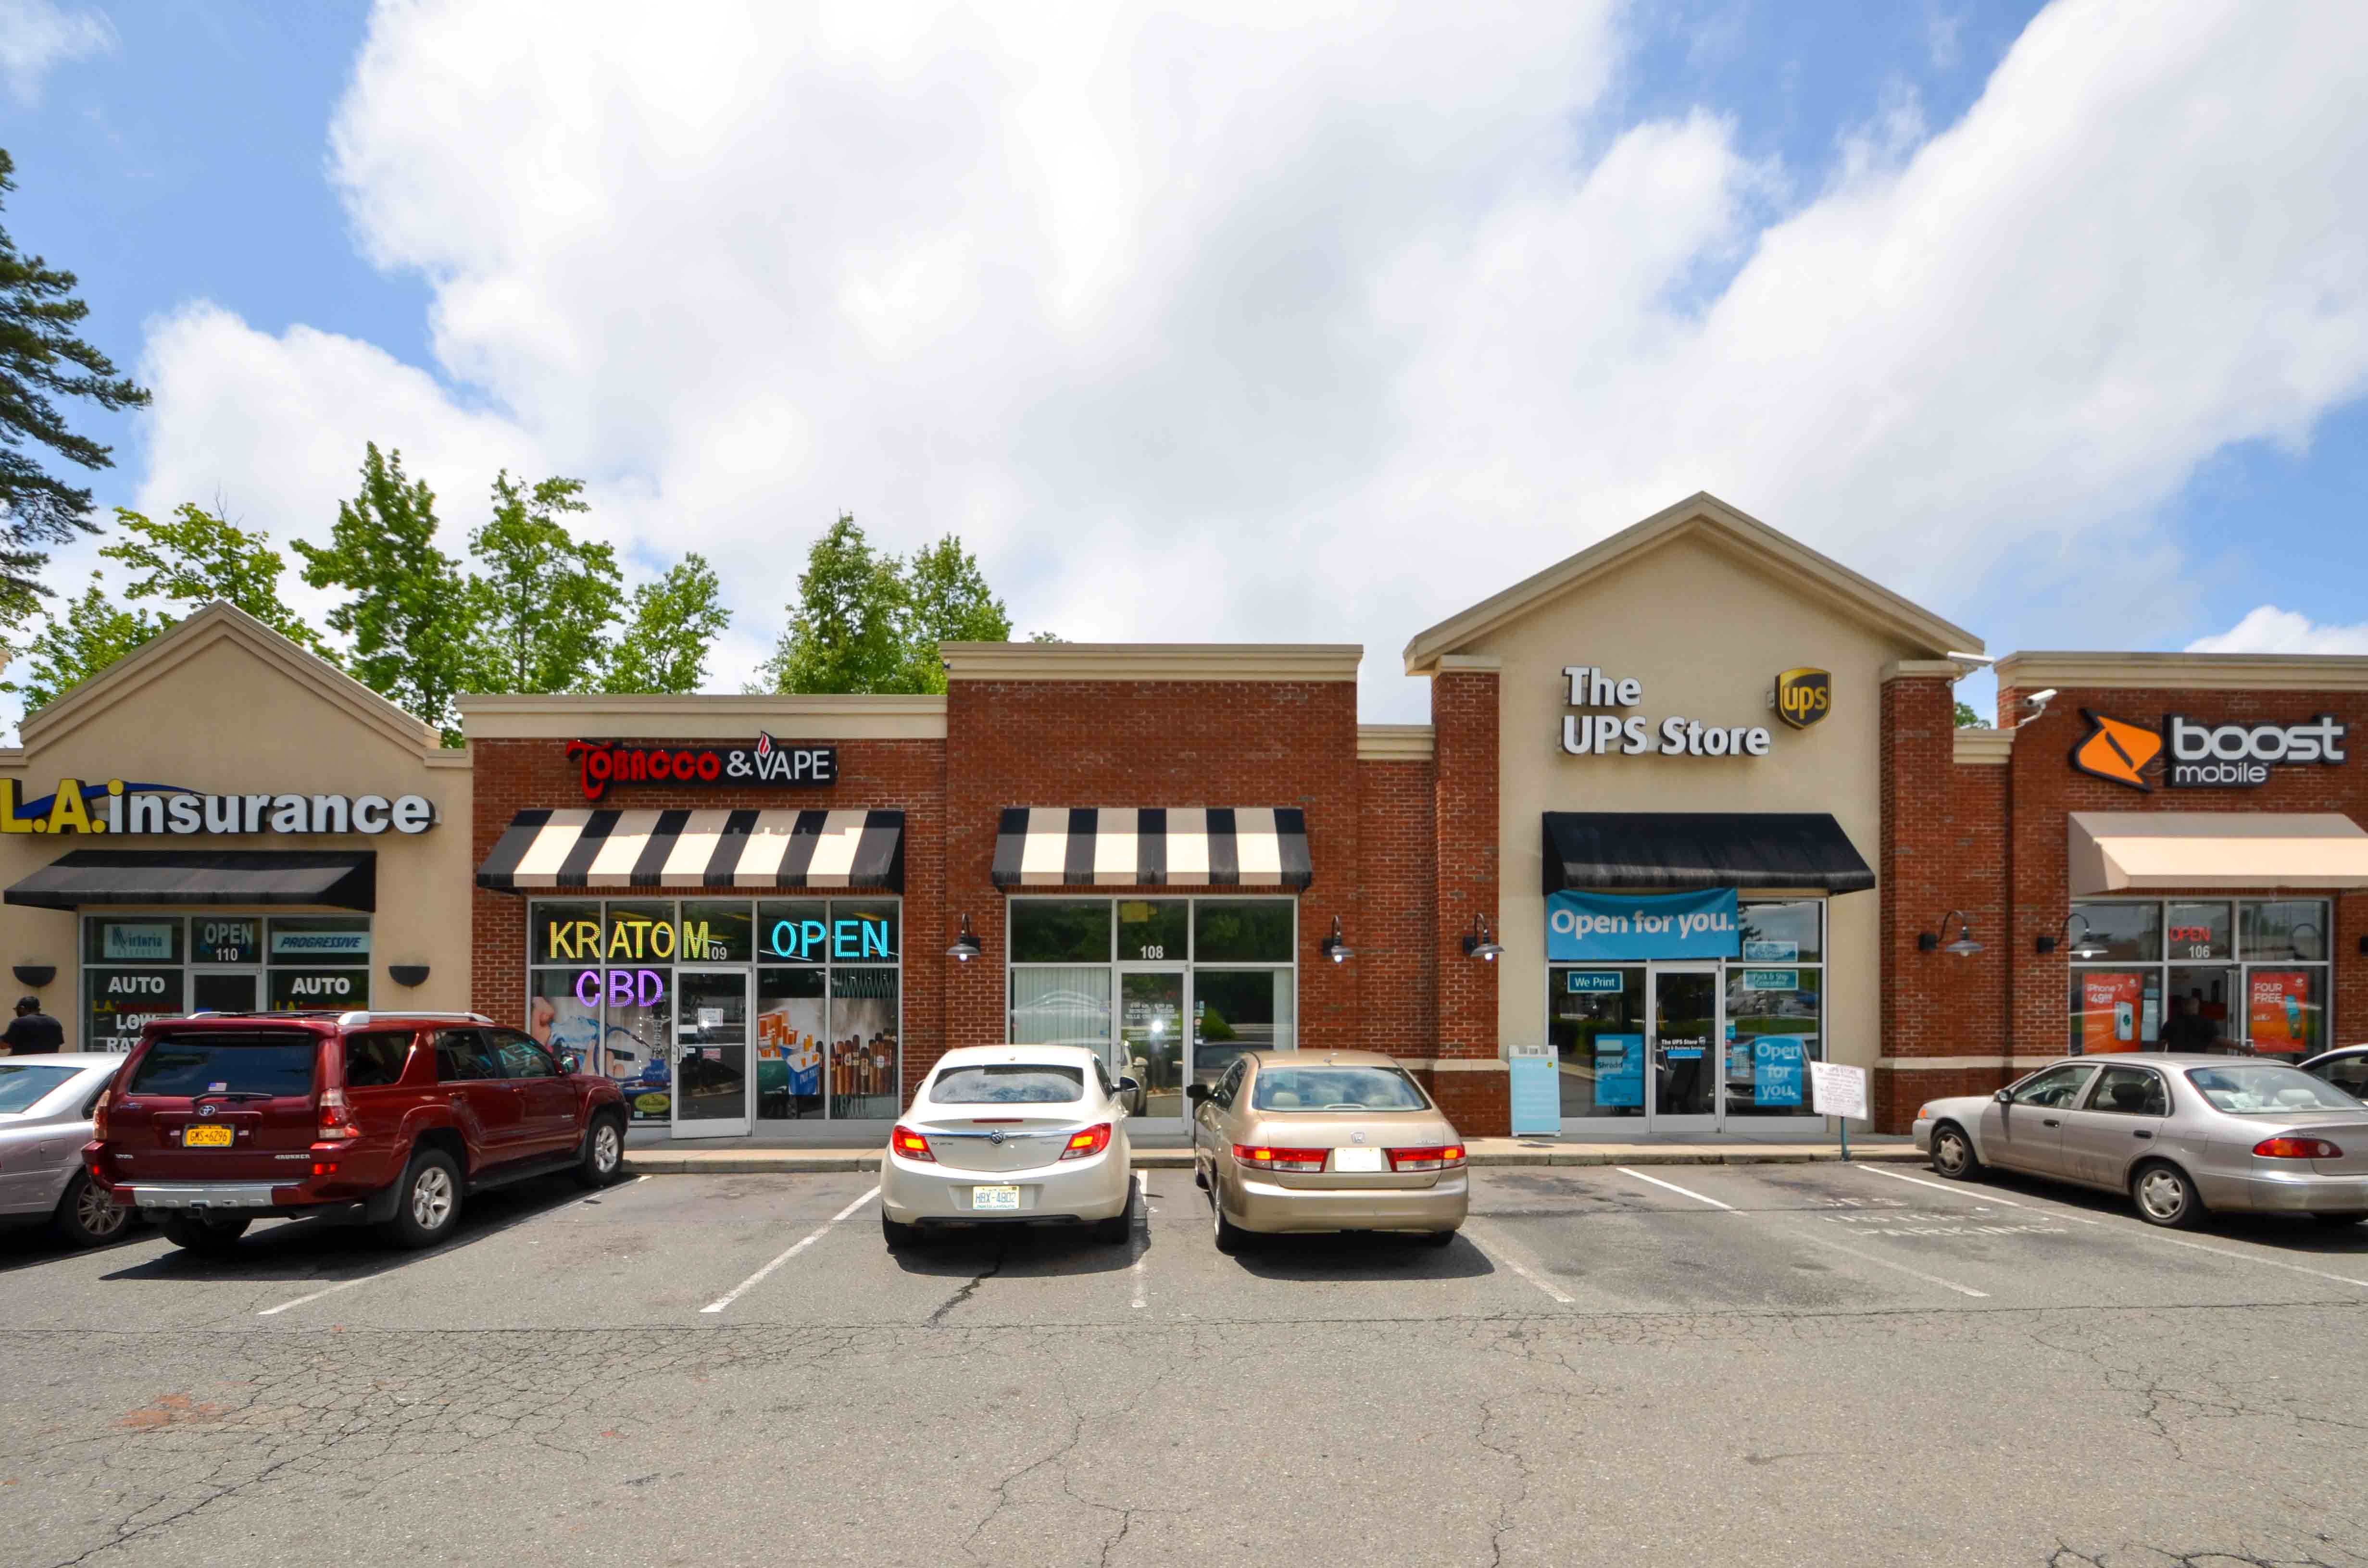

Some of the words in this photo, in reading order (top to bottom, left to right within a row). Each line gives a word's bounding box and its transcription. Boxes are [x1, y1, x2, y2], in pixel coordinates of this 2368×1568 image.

[1565, 667, 1641, 706] The
[1783, 685, 1827, 720] ups
[1563, 716, 1648, 755] UPS
[1662, 716, 1771, 756] Store
[2174, 717, 2344, 760] boost
[2175, 762, 2267, 783] mobile
[1551, 909, 1628, 939] Open
[1635, 909, 1673, 933] for
[1679, 912, 1735, 939] you.
[204, 923, 254, 945] OPEN
[281, 936, 362, 948] PROGRESSIVE
[550, 921, 709, 959] KRATOM
[772, 921, 888, 958] OPEN
[2169, 926, 2211, 942] OPEN
[215, 948, 238, 961] 110
[1140, 946, 1164, 959] 108
[2188, 946, 2210, 958] 106
[108, 976, 166, 994] AUTO
[291, 977, 351, 995] AUTO
[576, 971, 664, 1008] CBD
[1574, 977, 1591, 988] We
[1593, 977, 1615, 988] Print
[2254, 983, 2283, 992] FOUR
[2254, 993, 2282, 1003] FREE
[1757, 1043, 1801, 1061] Open
[1767, 1062, 1792, 1078] for
[1762, 1085, 1797, 1100] you.
